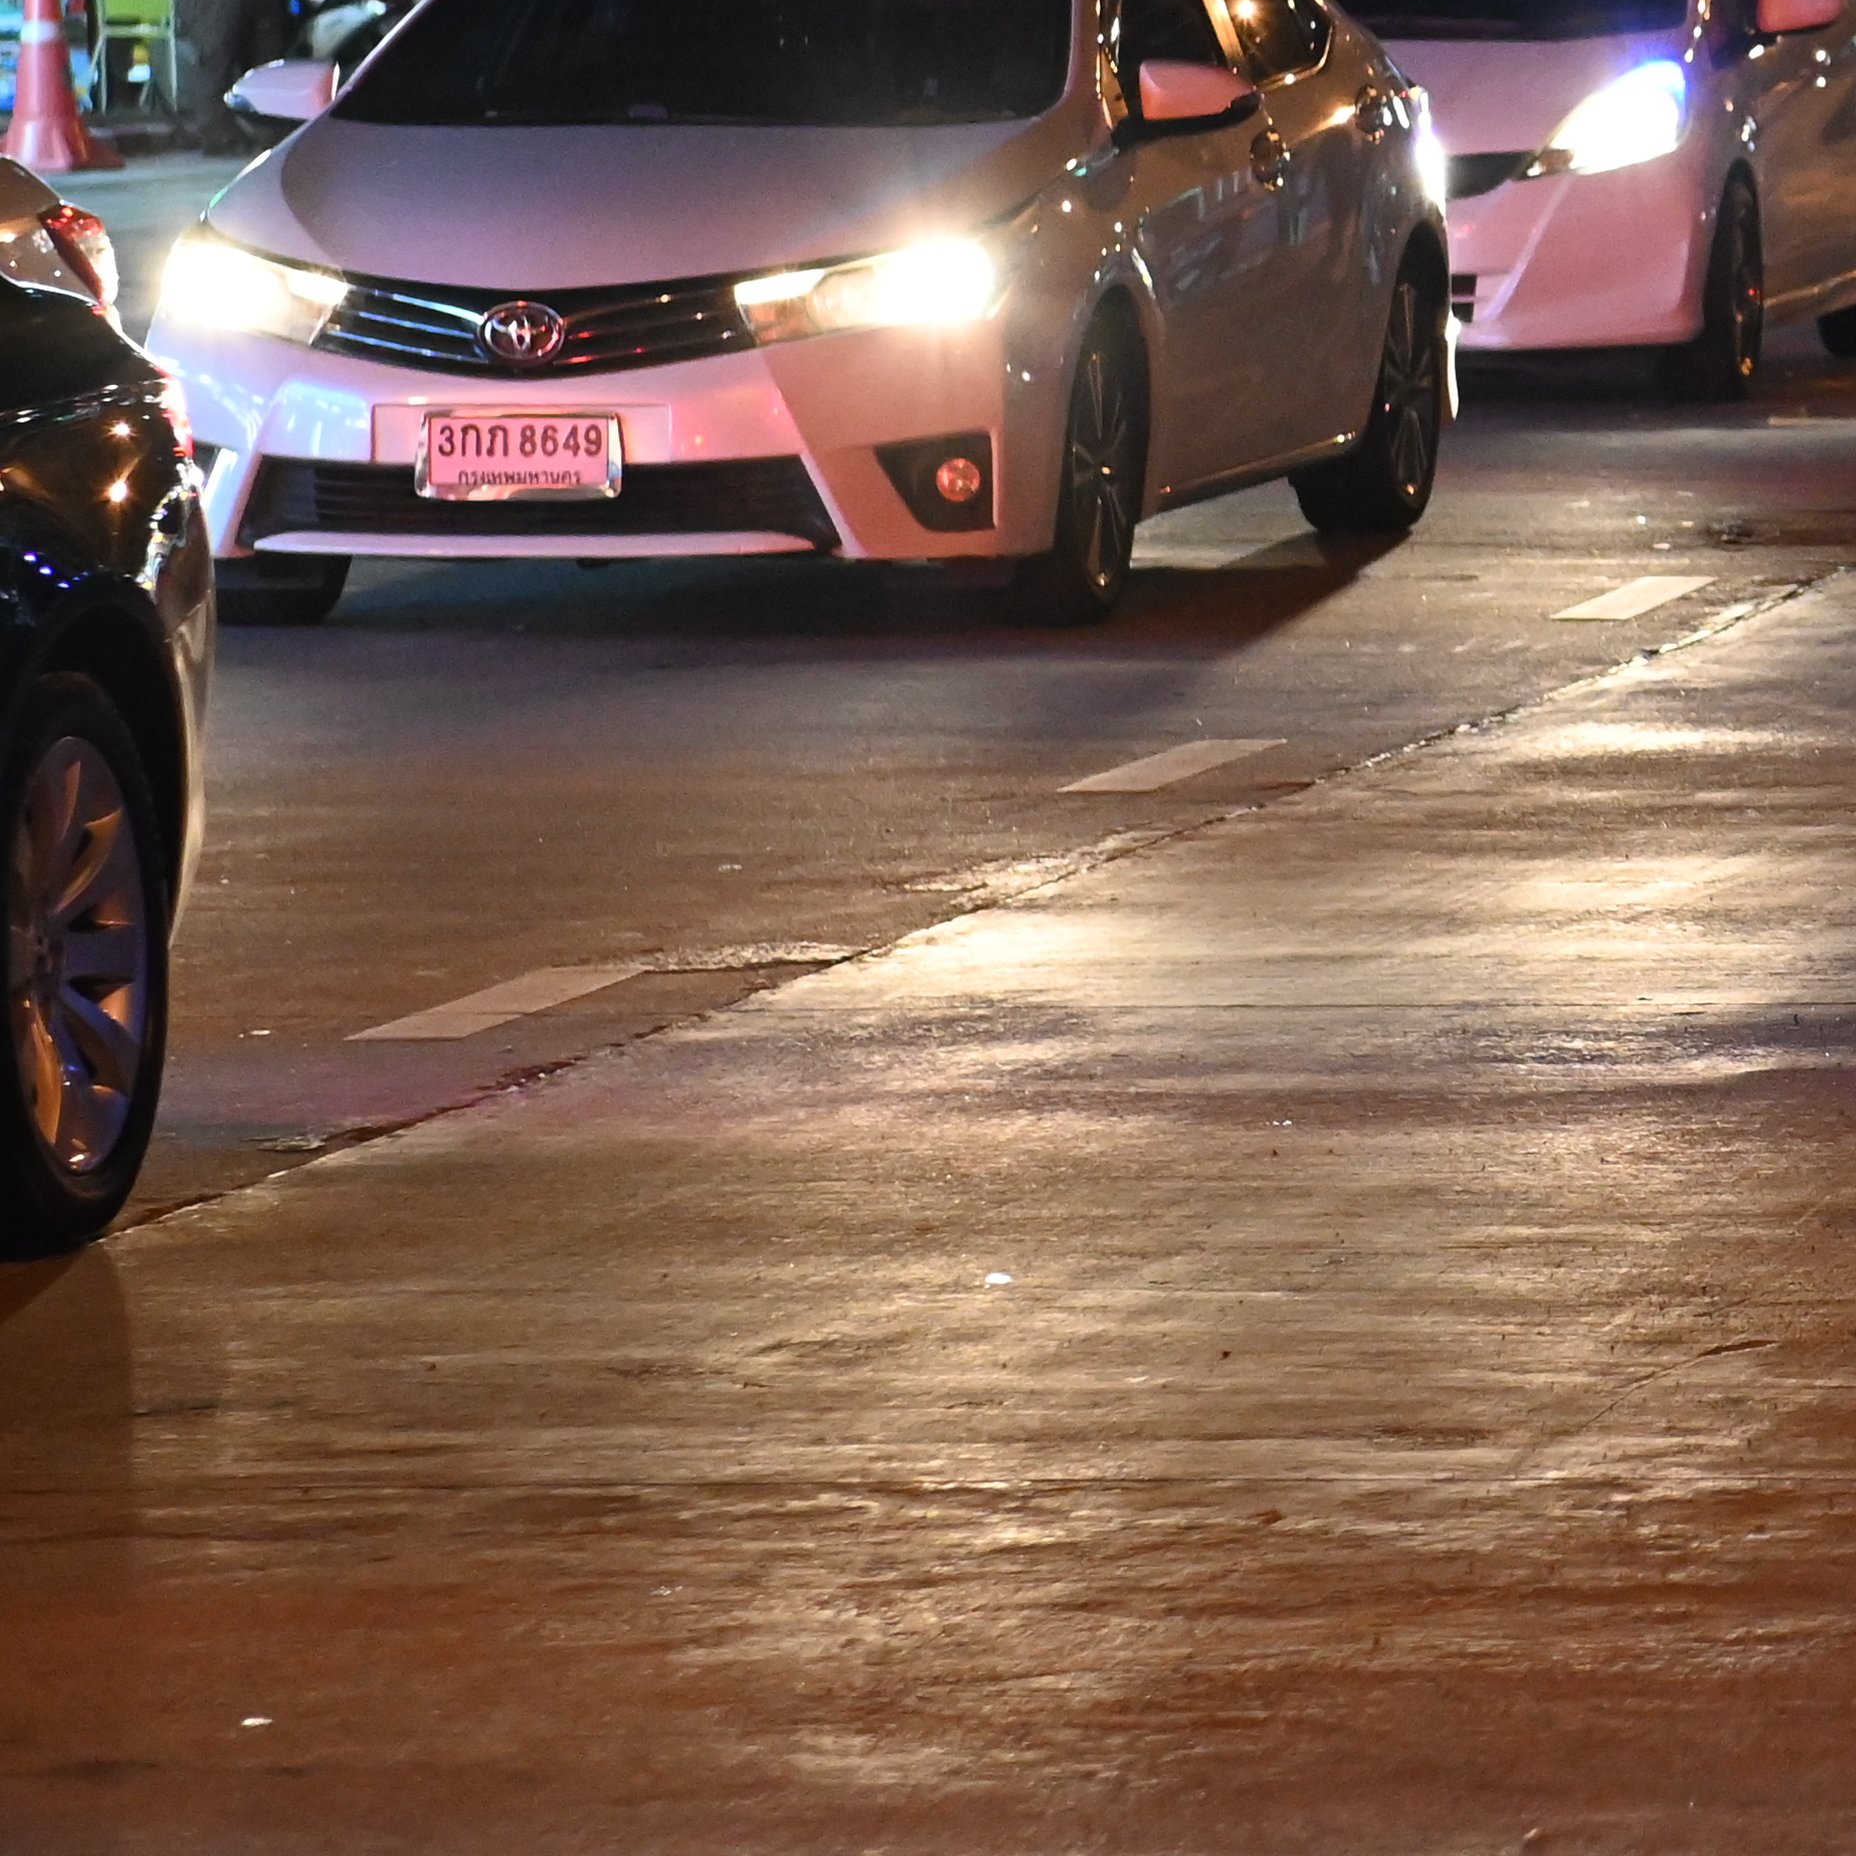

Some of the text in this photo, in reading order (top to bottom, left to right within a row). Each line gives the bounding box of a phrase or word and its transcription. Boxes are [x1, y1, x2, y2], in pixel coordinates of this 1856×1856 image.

[438, 423, 602, 457] 3กภ 8649
[457, 469, 583, 486] กรงเทพมหานคร
